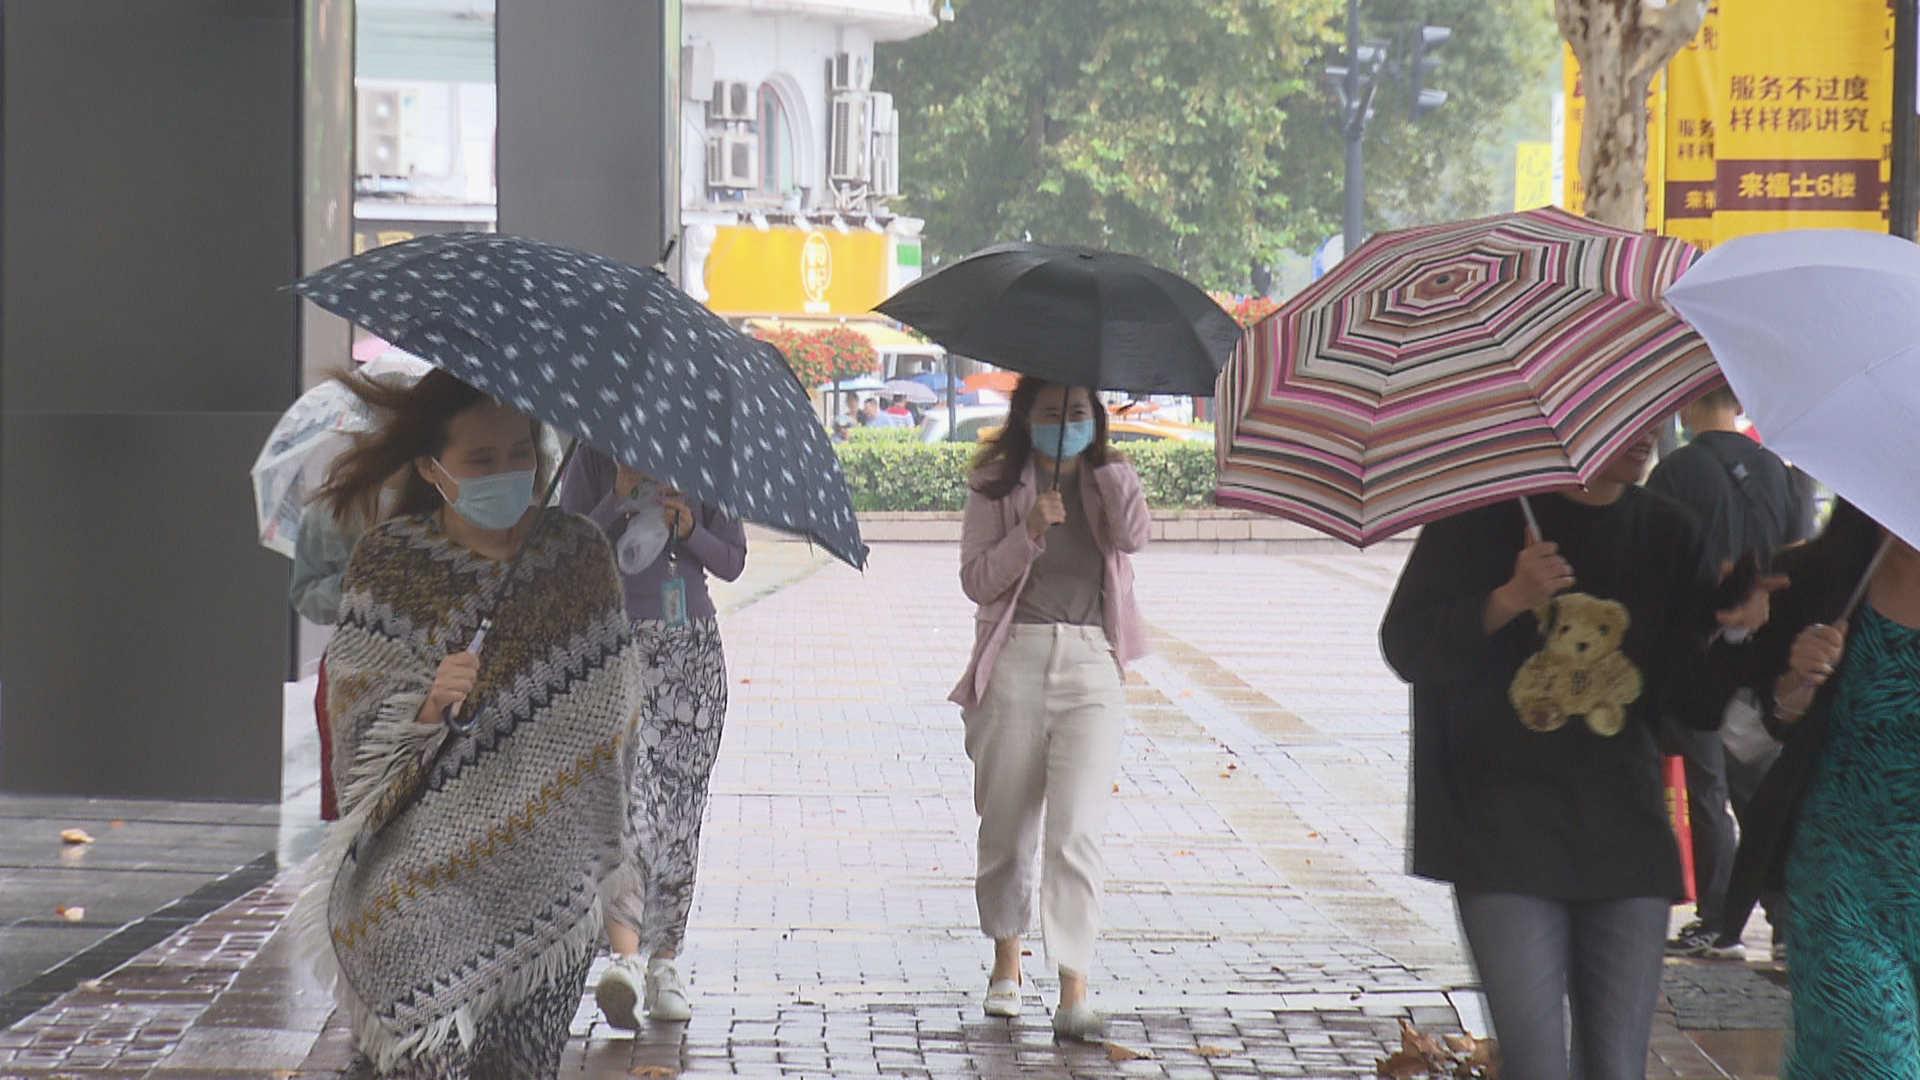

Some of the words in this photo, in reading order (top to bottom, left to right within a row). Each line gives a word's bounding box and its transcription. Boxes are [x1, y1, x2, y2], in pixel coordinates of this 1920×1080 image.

[1730, 75, 1869, 101] 服务不过度
[1730, 107, 1869, 132] 样样都讲究
[1738, 172, 1857, 199] 来福士6楼
